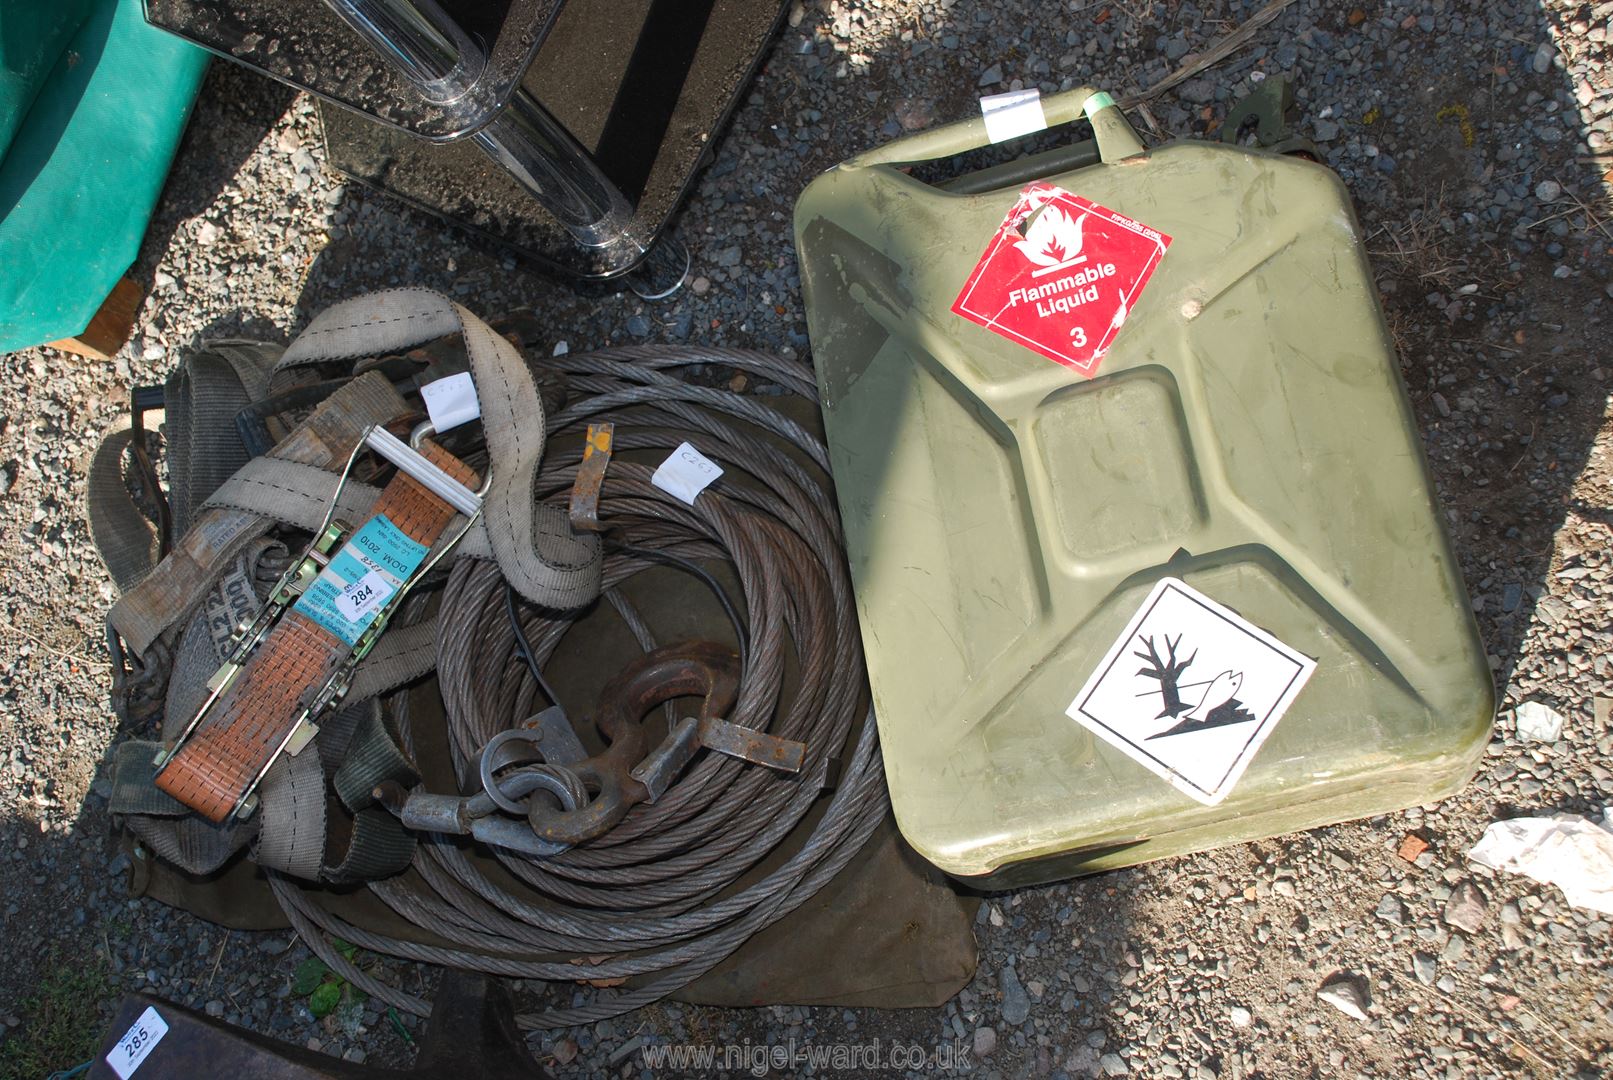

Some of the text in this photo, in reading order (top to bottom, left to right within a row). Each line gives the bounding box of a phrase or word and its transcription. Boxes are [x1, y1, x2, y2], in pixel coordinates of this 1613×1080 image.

[1009, 263, 1116, 307] Flammable
[1036, 285, 1099, 318] Liquid
[1069, 326, 1088, 347] 3
[213, 527, 236, 550] RATED
[359, 534, 381, 554] 2010
[351, 584, 373, 606] 284
[125, 1026, 148, 1058] 285
